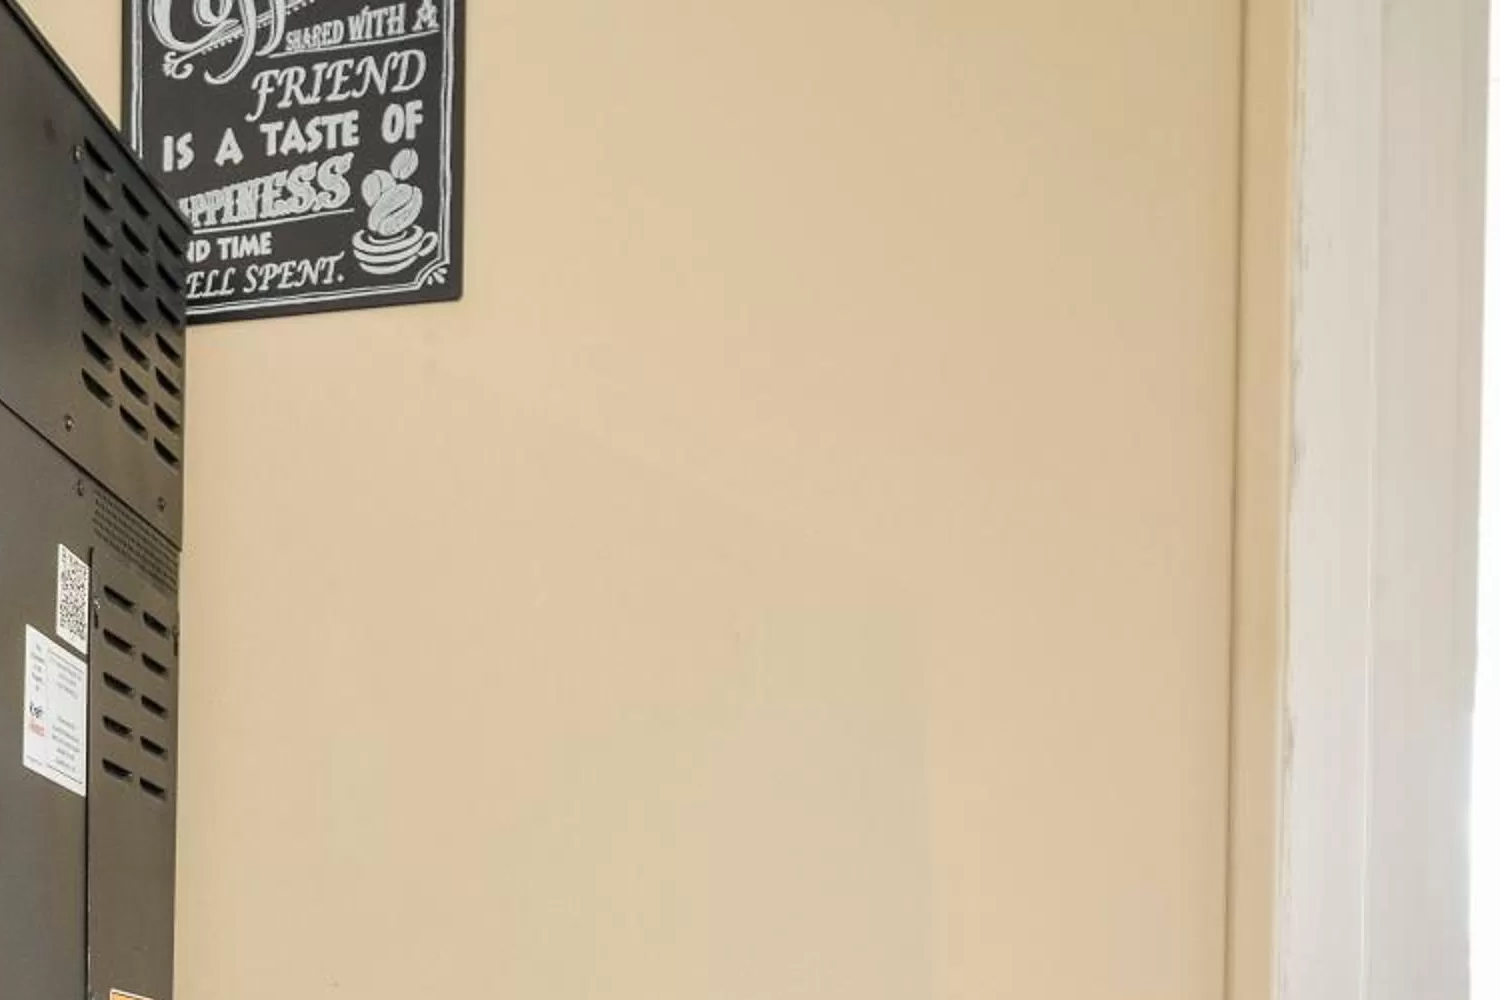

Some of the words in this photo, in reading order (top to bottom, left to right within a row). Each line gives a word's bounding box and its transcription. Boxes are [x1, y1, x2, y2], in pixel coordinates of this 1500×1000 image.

[285, 19, 345, 51] SHARED
[348, 4, 407, 41] WITH
[411, 0, 440, 31] A
[244, 49, 427, 122] FRIEND
[162, 131, 195, 173] IS
[215, 127, 245, 167] A
[259, 109, 360, 157] TASTE
[381, 100, 424, 144] OF
[179, 152, 355, 228] PPINESS
[185, 266, 237, 299] ELL
[243, 251, 345, 294] SPENT.
[216, 231, 273, 261] TIME
